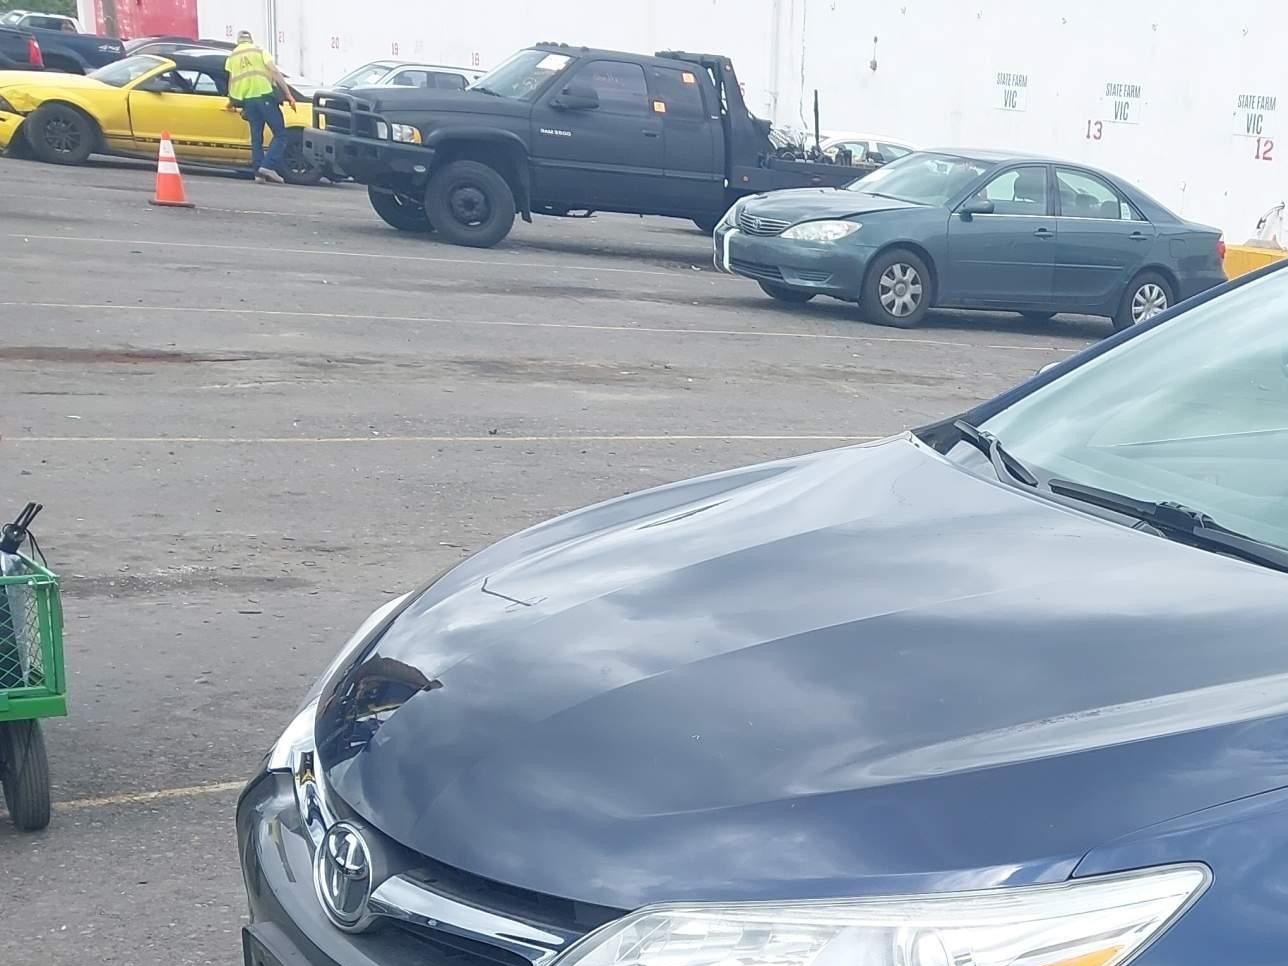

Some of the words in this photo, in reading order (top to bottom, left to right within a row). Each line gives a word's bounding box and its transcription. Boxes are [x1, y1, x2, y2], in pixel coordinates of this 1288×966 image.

[331, 36, 340, 50] 20
[391, 42, 399, 56] 19
[471, 50, 480, 67] 18
[996, 72, 1011, 87] STATE
[1012, 74, 1028, 88] FARM
[1105, 82, 1123, 98] STATE
[1123, 83, 1141, 98] FARM
[1003, 89, 1018, 109] VIC
[1237, 94, 1256, 110] STATE
[1256, 95, 1277, 111] FARM
[1114, 101, 1130, 121] VIC
[1086, 119, 1103, 140] 13
[1246, 113, 1263, 135] VIC
[1255, 137, 1274, 161] 12
